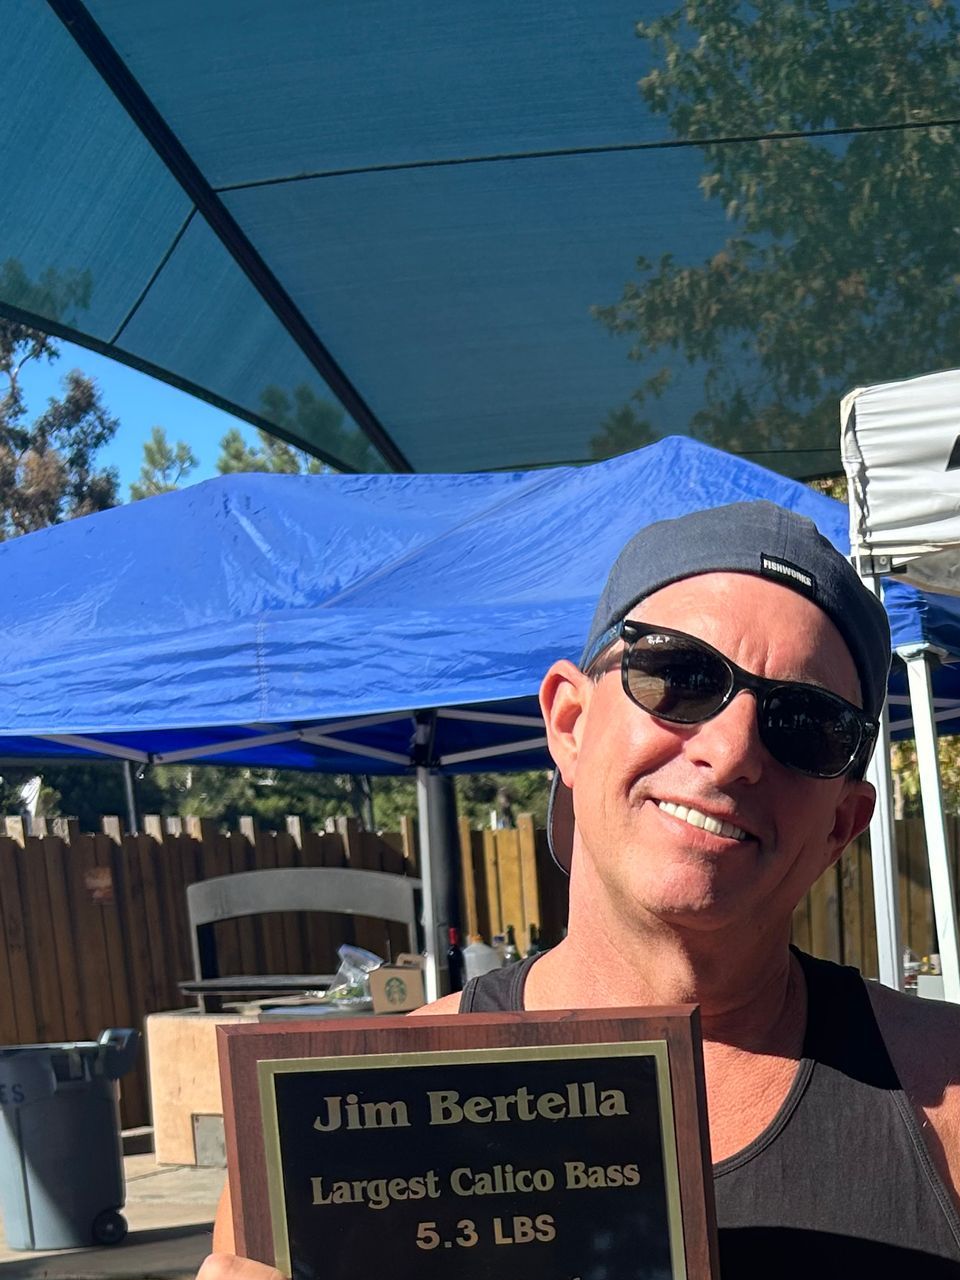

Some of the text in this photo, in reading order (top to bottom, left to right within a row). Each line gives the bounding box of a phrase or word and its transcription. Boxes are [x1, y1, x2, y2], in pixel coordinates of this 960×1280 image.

[763, 558, 812, 587] FISHWORKS
[314, 1082, 630, 1132] Jim Bertella
[311, 1162, 641, 1210] Largest Calico Bass
[416, 1215, 556, 1250] 5.3 LBS
